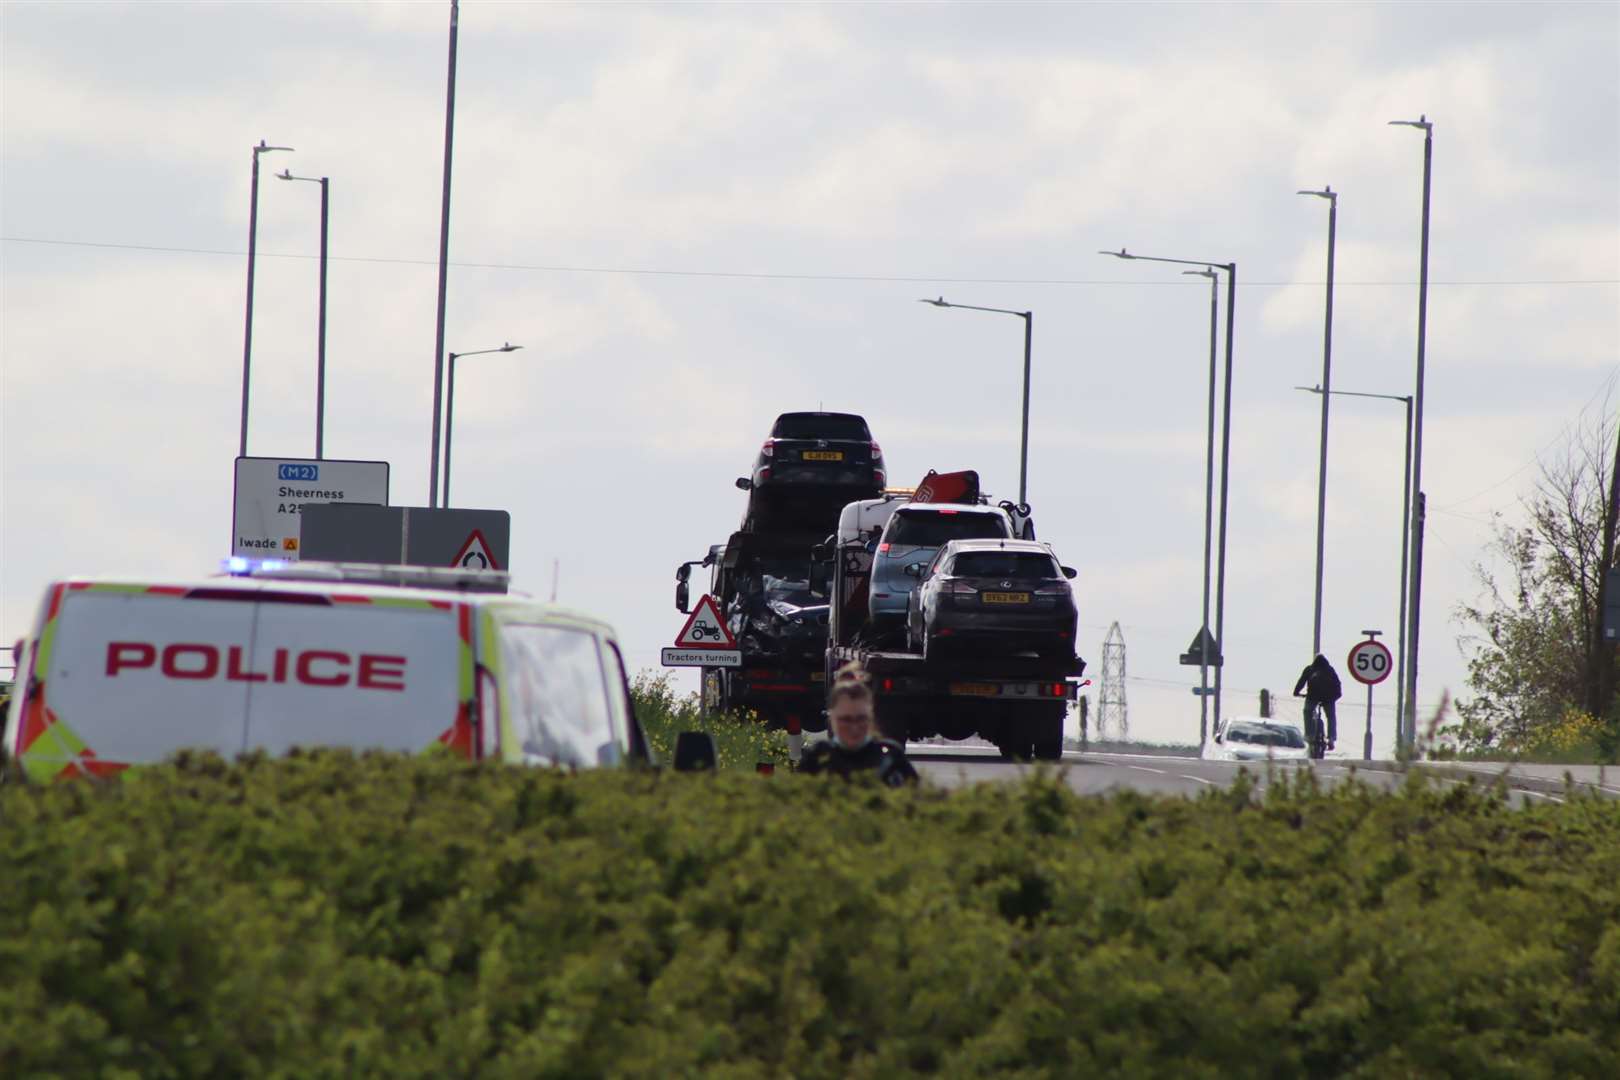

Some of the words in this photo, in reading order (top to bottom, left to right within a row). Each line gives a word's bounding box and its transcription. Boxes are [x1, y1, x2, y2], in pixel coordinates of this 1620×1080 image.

[279, 465, 317, 479] (M2)
[279, 486, 344, 499] Sheerness
[239, 537, 277, 549] Iwade
[667, 653, 703, 662] Tractors
[705, 654, 738, 664] turning
[1357, 653, 1386, 672] 50
[105, 641, 408, 692] POLICE
